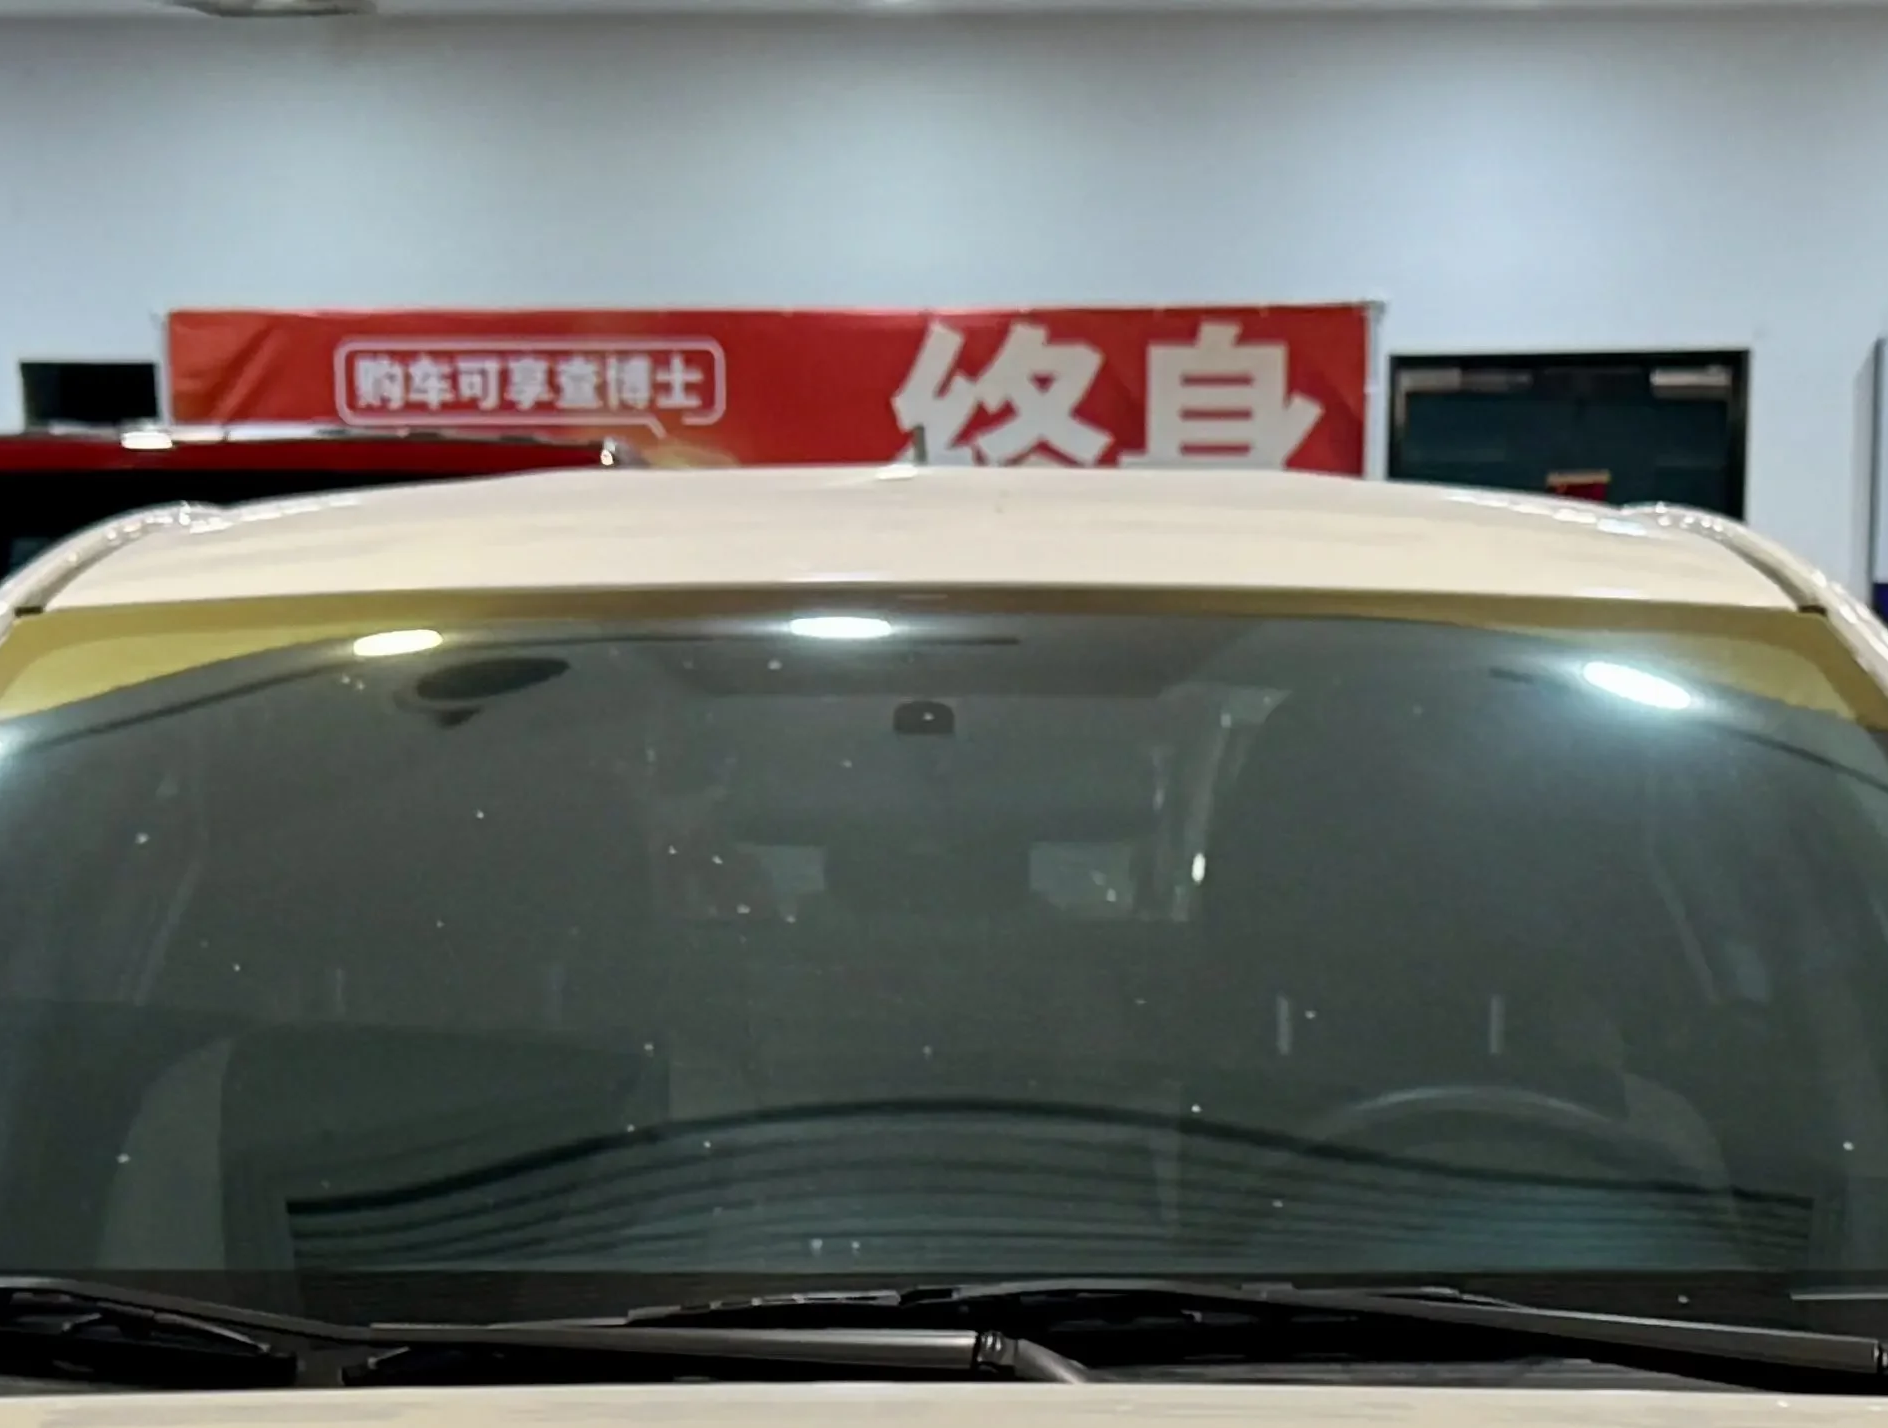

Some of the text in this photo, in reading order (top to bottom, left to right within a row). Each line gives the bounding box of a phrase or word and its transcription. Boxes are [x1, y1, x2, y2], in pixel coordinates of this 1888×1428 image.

[355, 353, 704, 410] 购车可享查博士
[891, 320, 1324, 468] 终身
